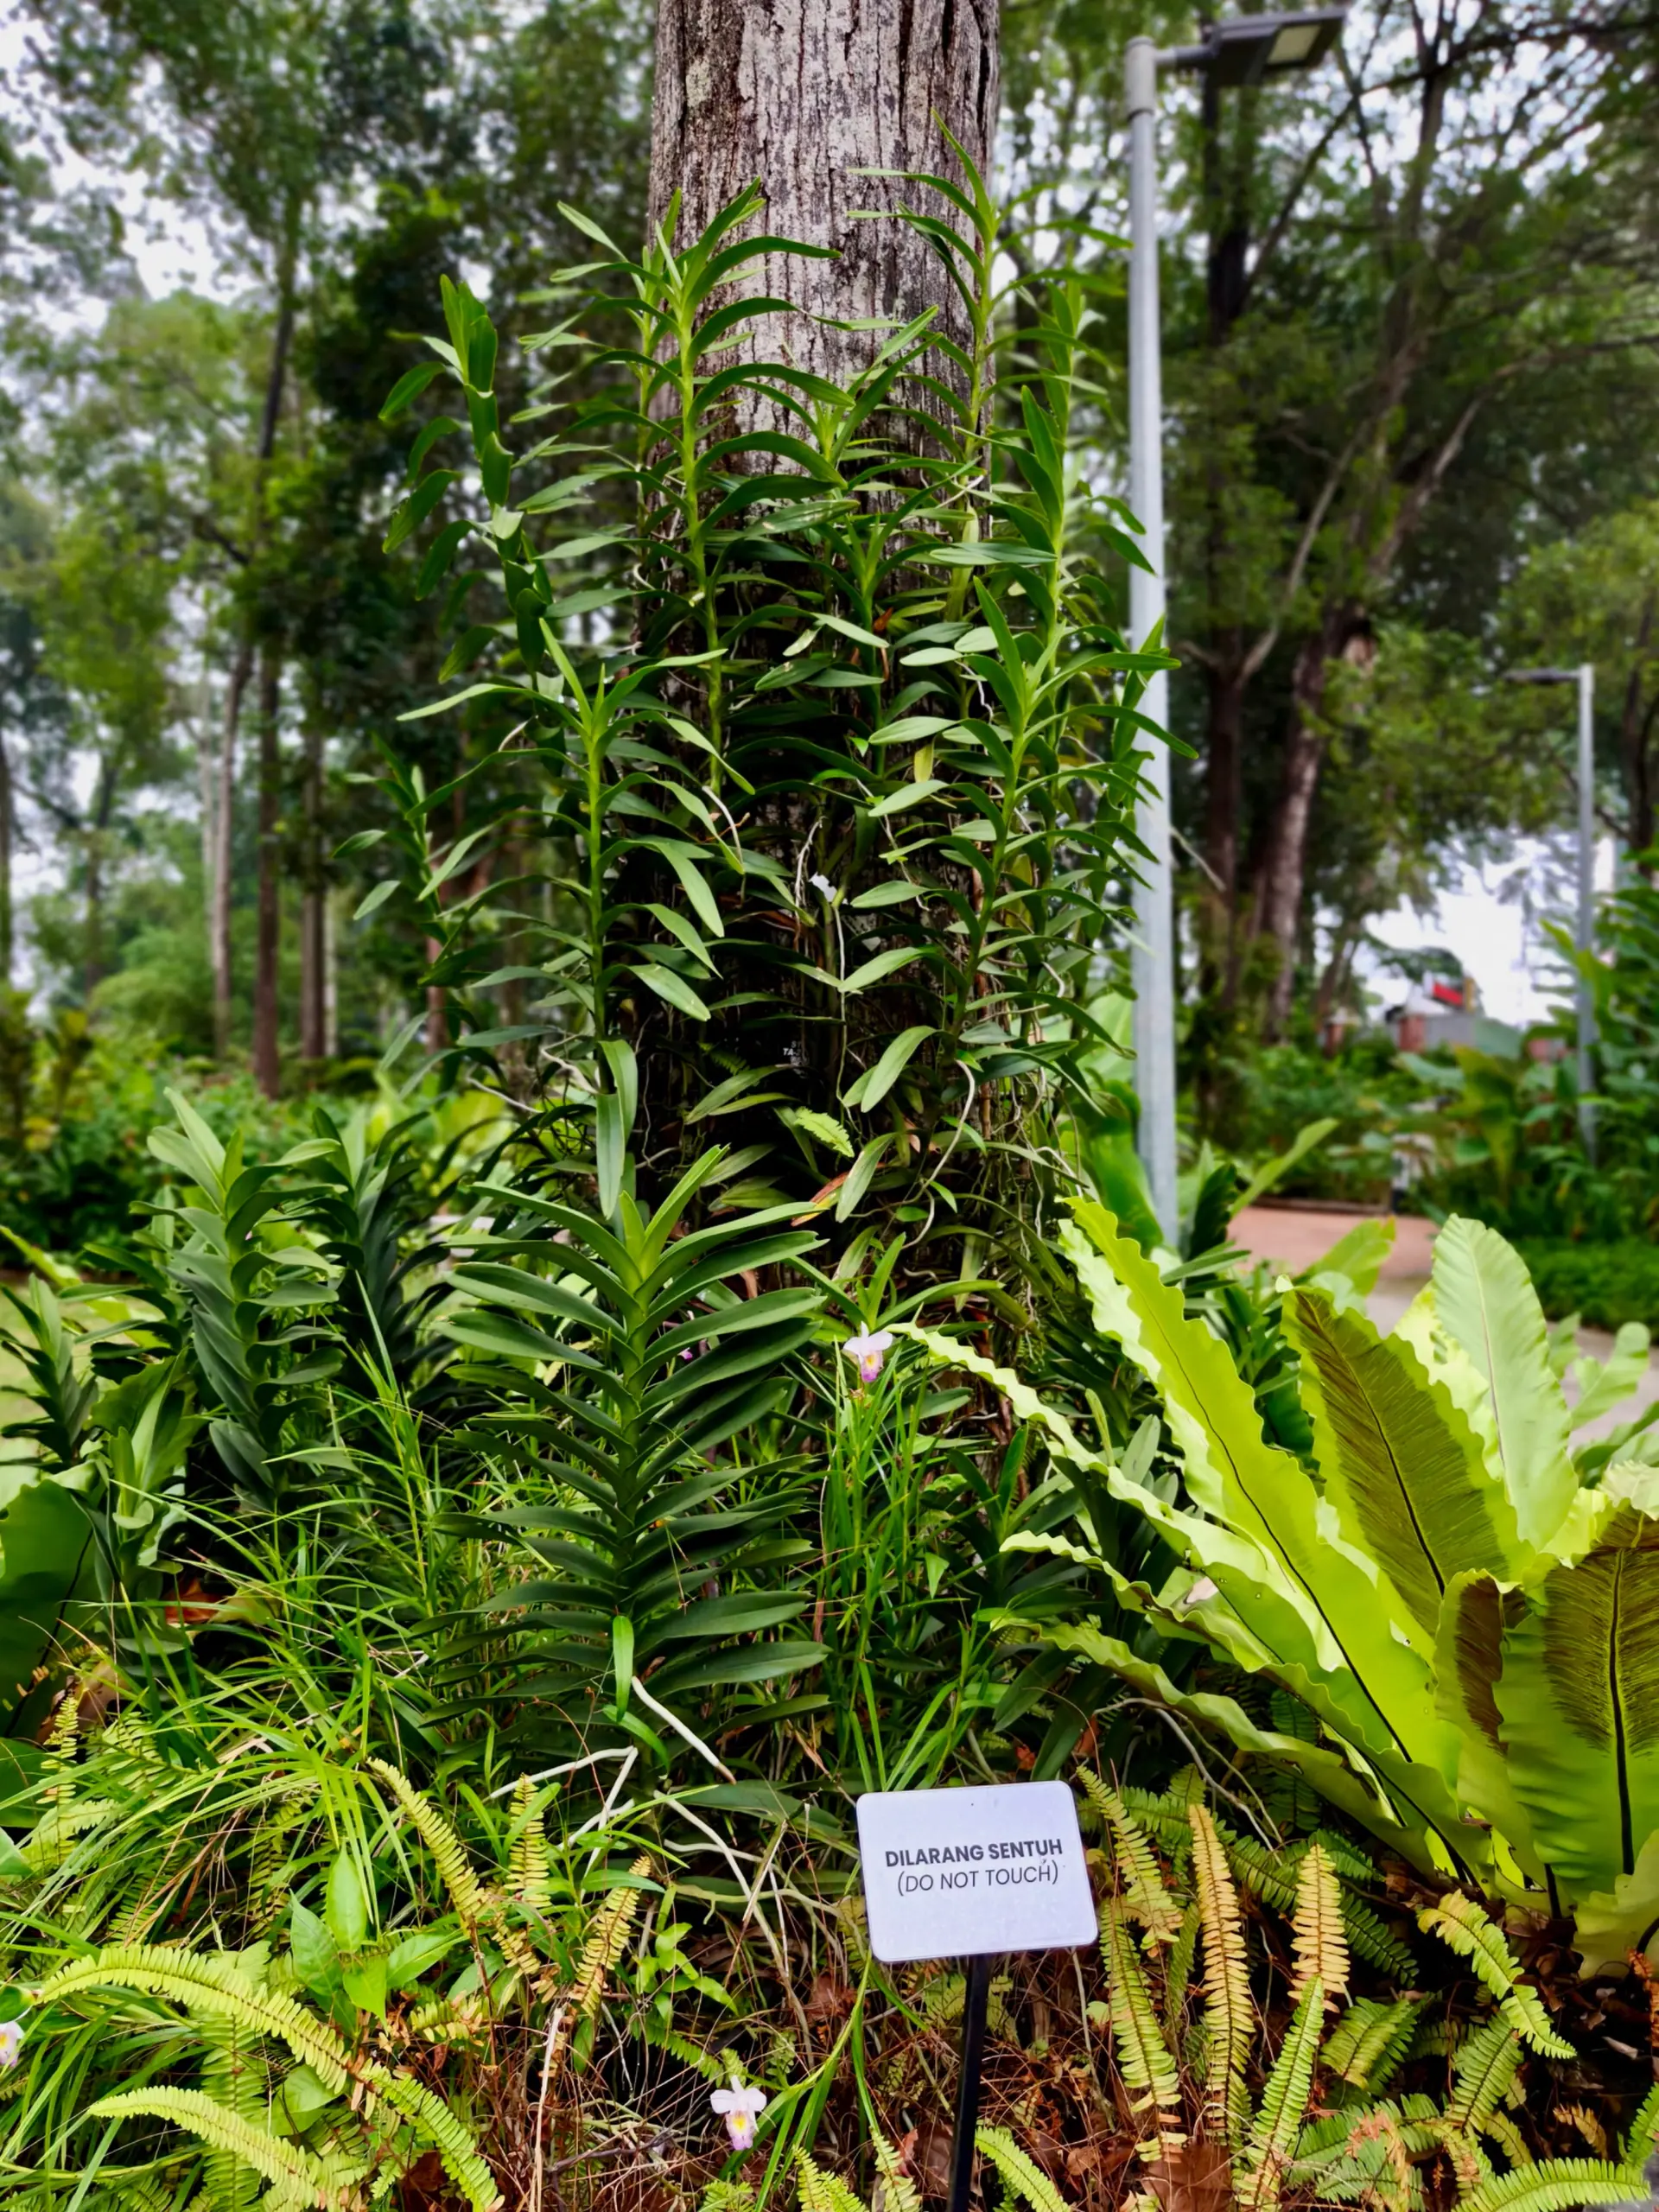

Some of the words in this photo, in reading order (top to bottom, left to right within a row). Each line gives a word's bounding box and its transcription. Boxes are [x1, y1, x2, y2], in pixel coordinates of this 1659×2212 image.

[885, 1844, 984, 1867] DILARANG
[988, 1838, 1063, 1859] SENTUH
[898, 1870, 934, 1897] (DO
[940, 1870, 979, 1890] NOT
[985, 1859, 1058, 1885] TOUCH)
